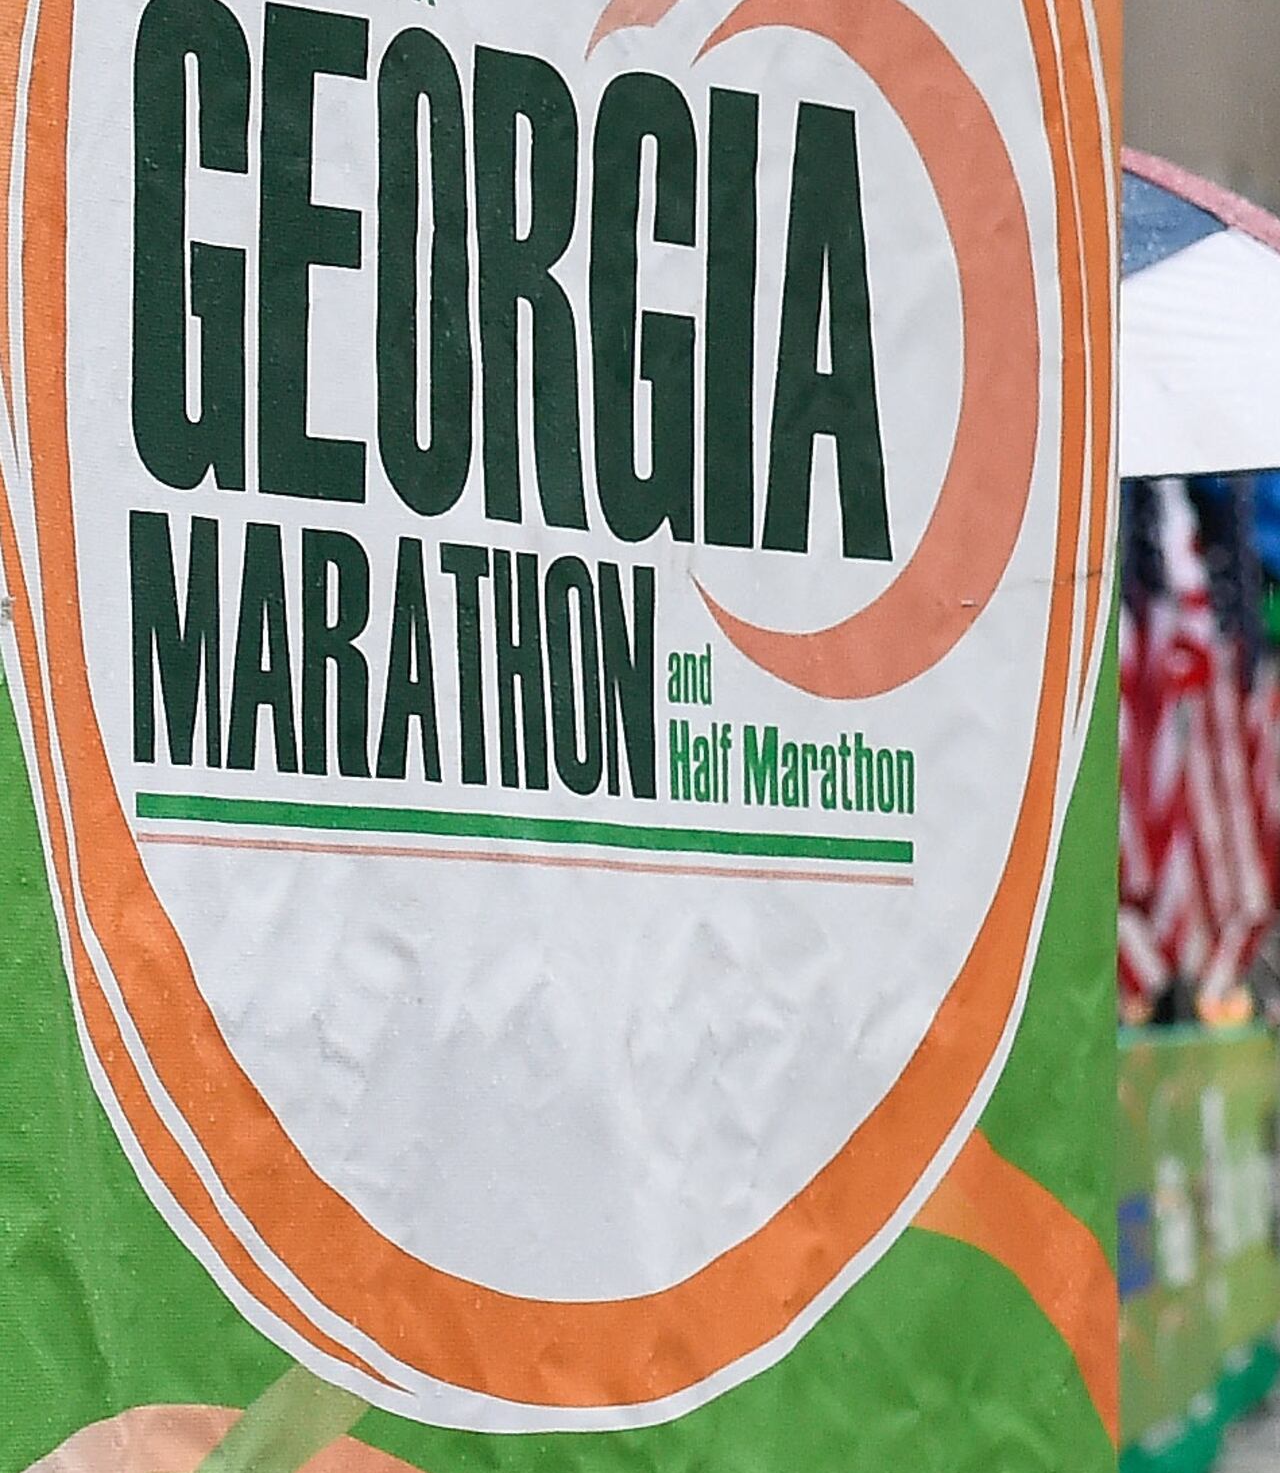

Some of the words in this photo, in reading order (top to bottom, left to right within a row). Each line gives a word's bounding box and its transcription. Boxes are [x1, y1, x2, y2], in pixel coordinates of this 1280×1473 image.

[130, 510, 657, 800] MARATHON
[668, 643, 712, 706] and
[669, 719, 732, 804] Half
[743, 725, 915, 815] Marathon
